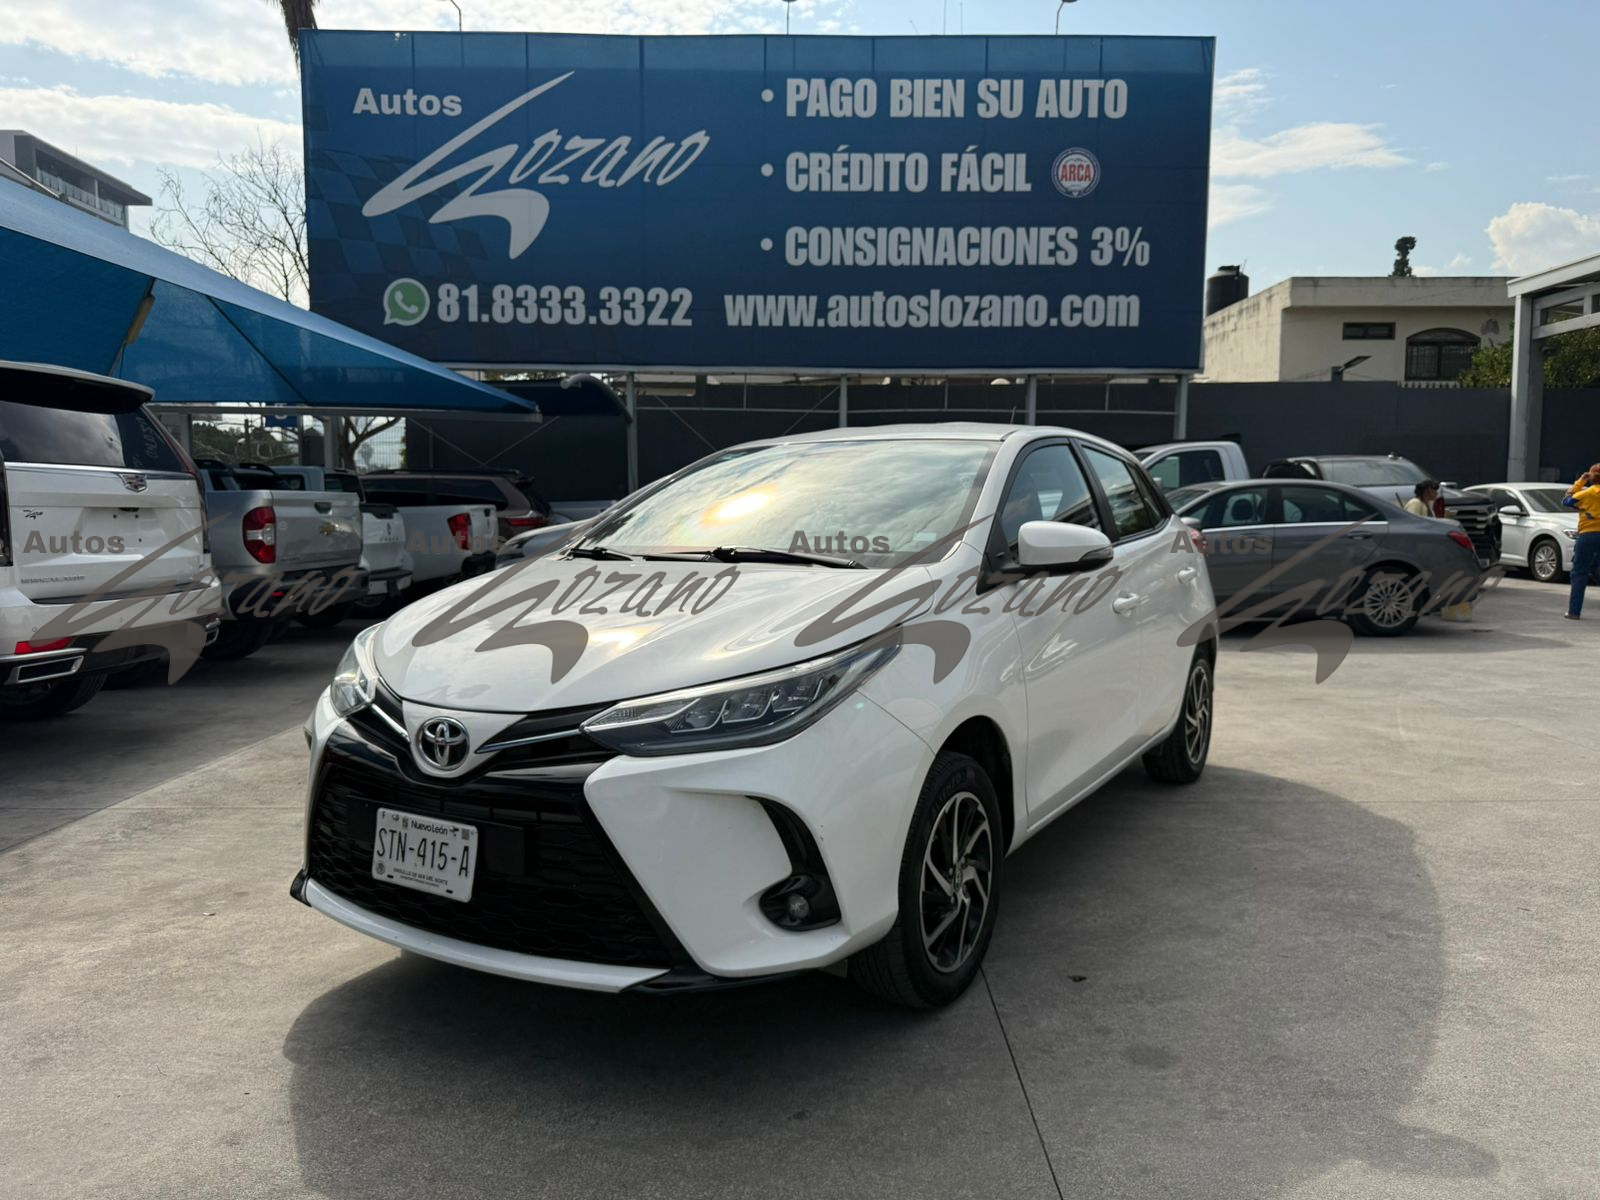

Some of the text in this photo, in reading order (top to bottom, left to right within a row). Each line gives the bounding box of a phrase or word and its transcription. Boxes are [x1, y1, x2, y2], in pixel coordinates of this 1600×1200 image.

[353, 87, 463, 117] Autos
[785, 78, 1128, 119] PAGO BIEN SU AUTO
[361, 70, 710, 260] Lozano
[785, 144, 1032, 193] CRÉDITO FÁCIL
[1060, 163, 1092, 182] ARCA
[784, 226, 1151, 268] CONSIGNACIONES 3%
[437, 283, 693, 328] 81.8333.3322
[724, 289, 1140, 329] www.autoslozano.com
[377, 828, 470, 877] STN-415-A
